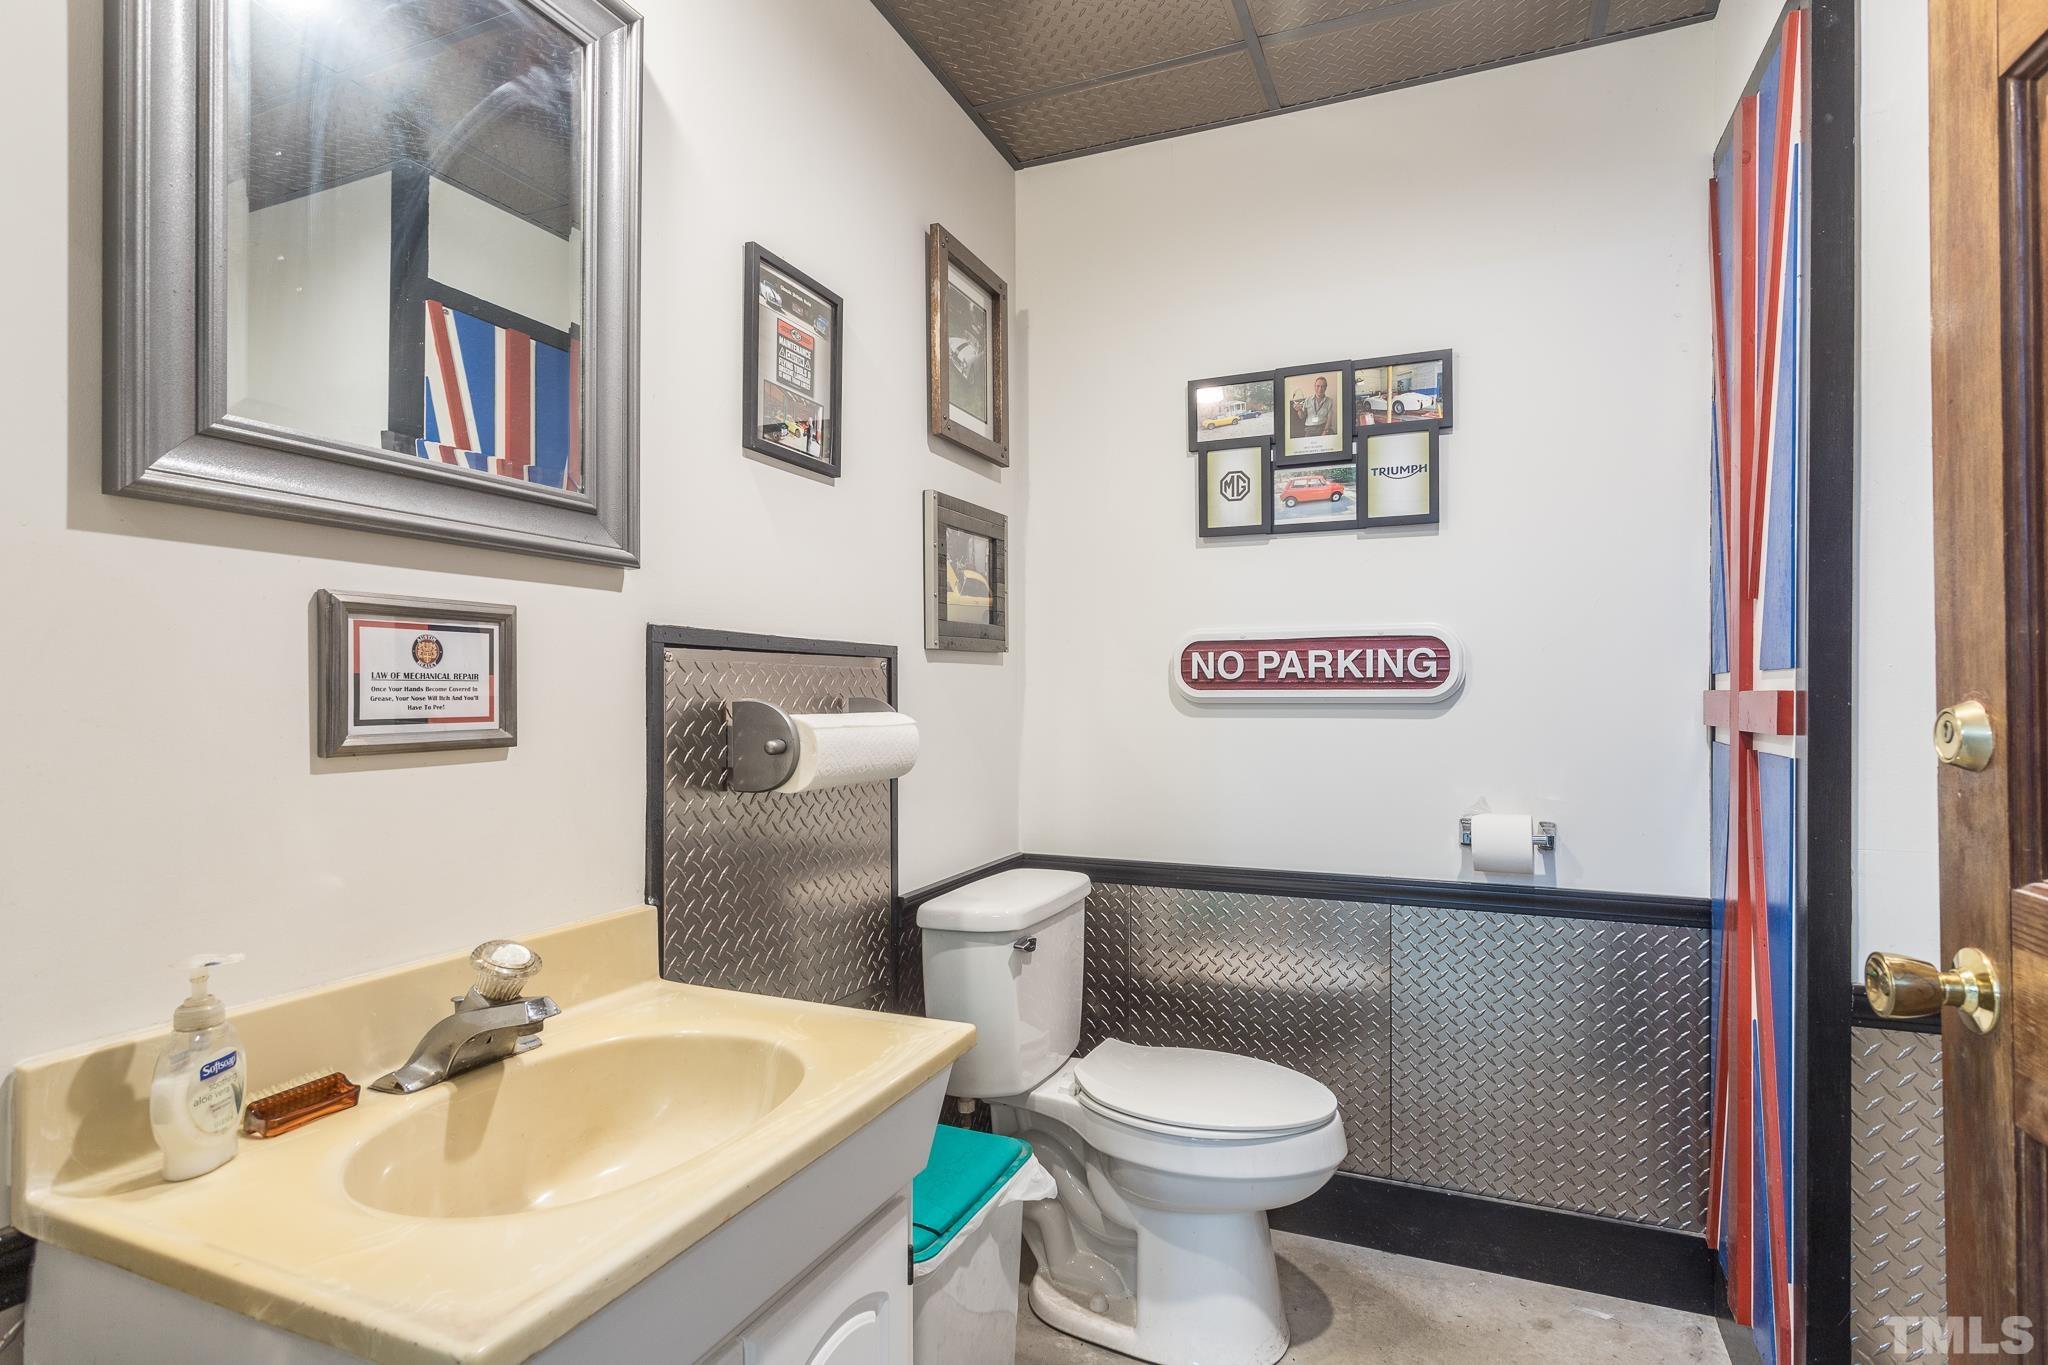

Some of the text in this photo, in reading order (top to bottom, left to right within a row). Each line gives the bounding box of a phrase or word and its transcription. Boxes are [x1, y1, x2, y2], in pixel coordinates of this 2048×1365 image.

[1371, 463, 1428, 478] TRIUMPH
[1222, 476, 1248, 499] MG
[1191, 647, 1438, 680] NO PARKING
[371, 671, 389, 680] LAW
[390, 671, 401, 680] OF
[403, 672, 450, 680] MECHANICAL
[202, 1055, 236, 1077] Softsoap
[193, 1094, 213, 1107] aloe
